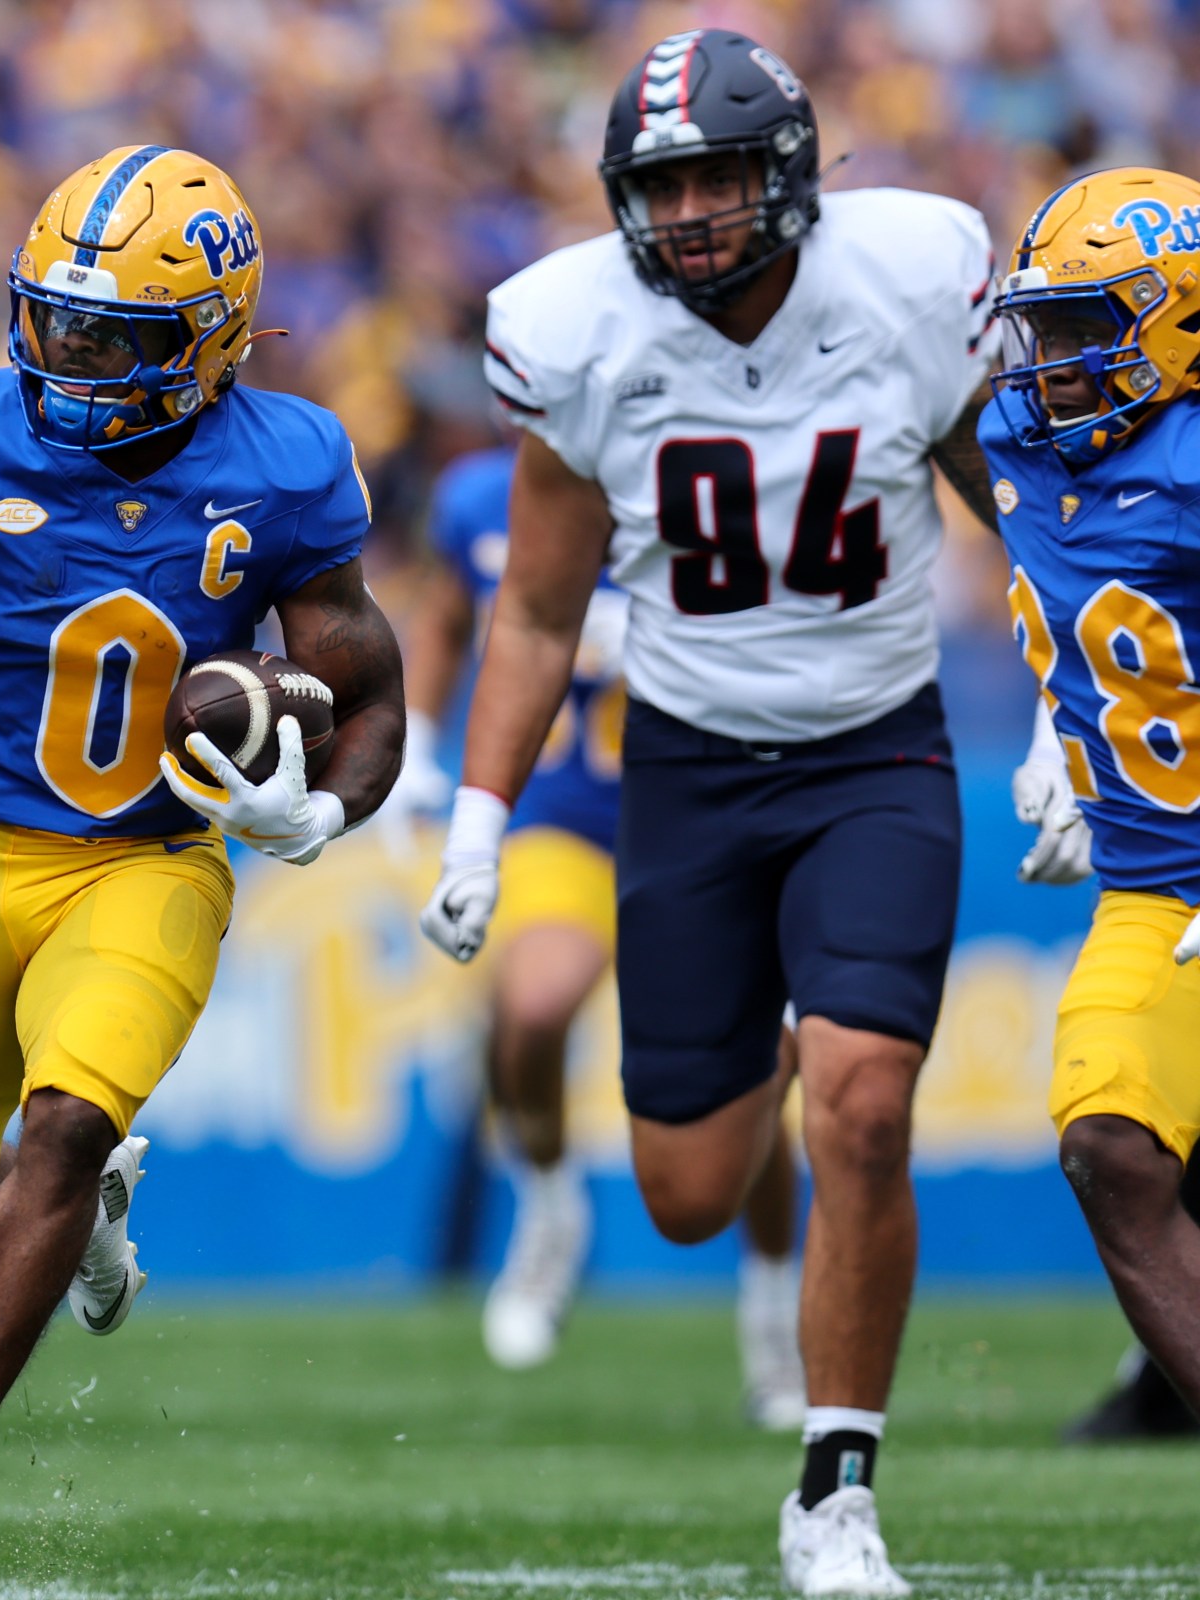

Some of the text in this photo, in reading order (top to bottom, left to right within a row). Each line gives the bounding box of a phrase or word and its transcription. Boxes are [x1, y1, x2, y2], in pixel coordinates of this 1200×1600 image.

[183, 208, 259, 279] Pitt
[1112, 198, 1200, 258] Pit
[67, 269, 88, 285] H2P
[136, 293, 176, 303] OAKLEY
[657, 427, 888, 616] 94
[200, 520, 252, 600] C
[35, 588, 187, 819] 0
[1007, 565, 1200, 813] 28
